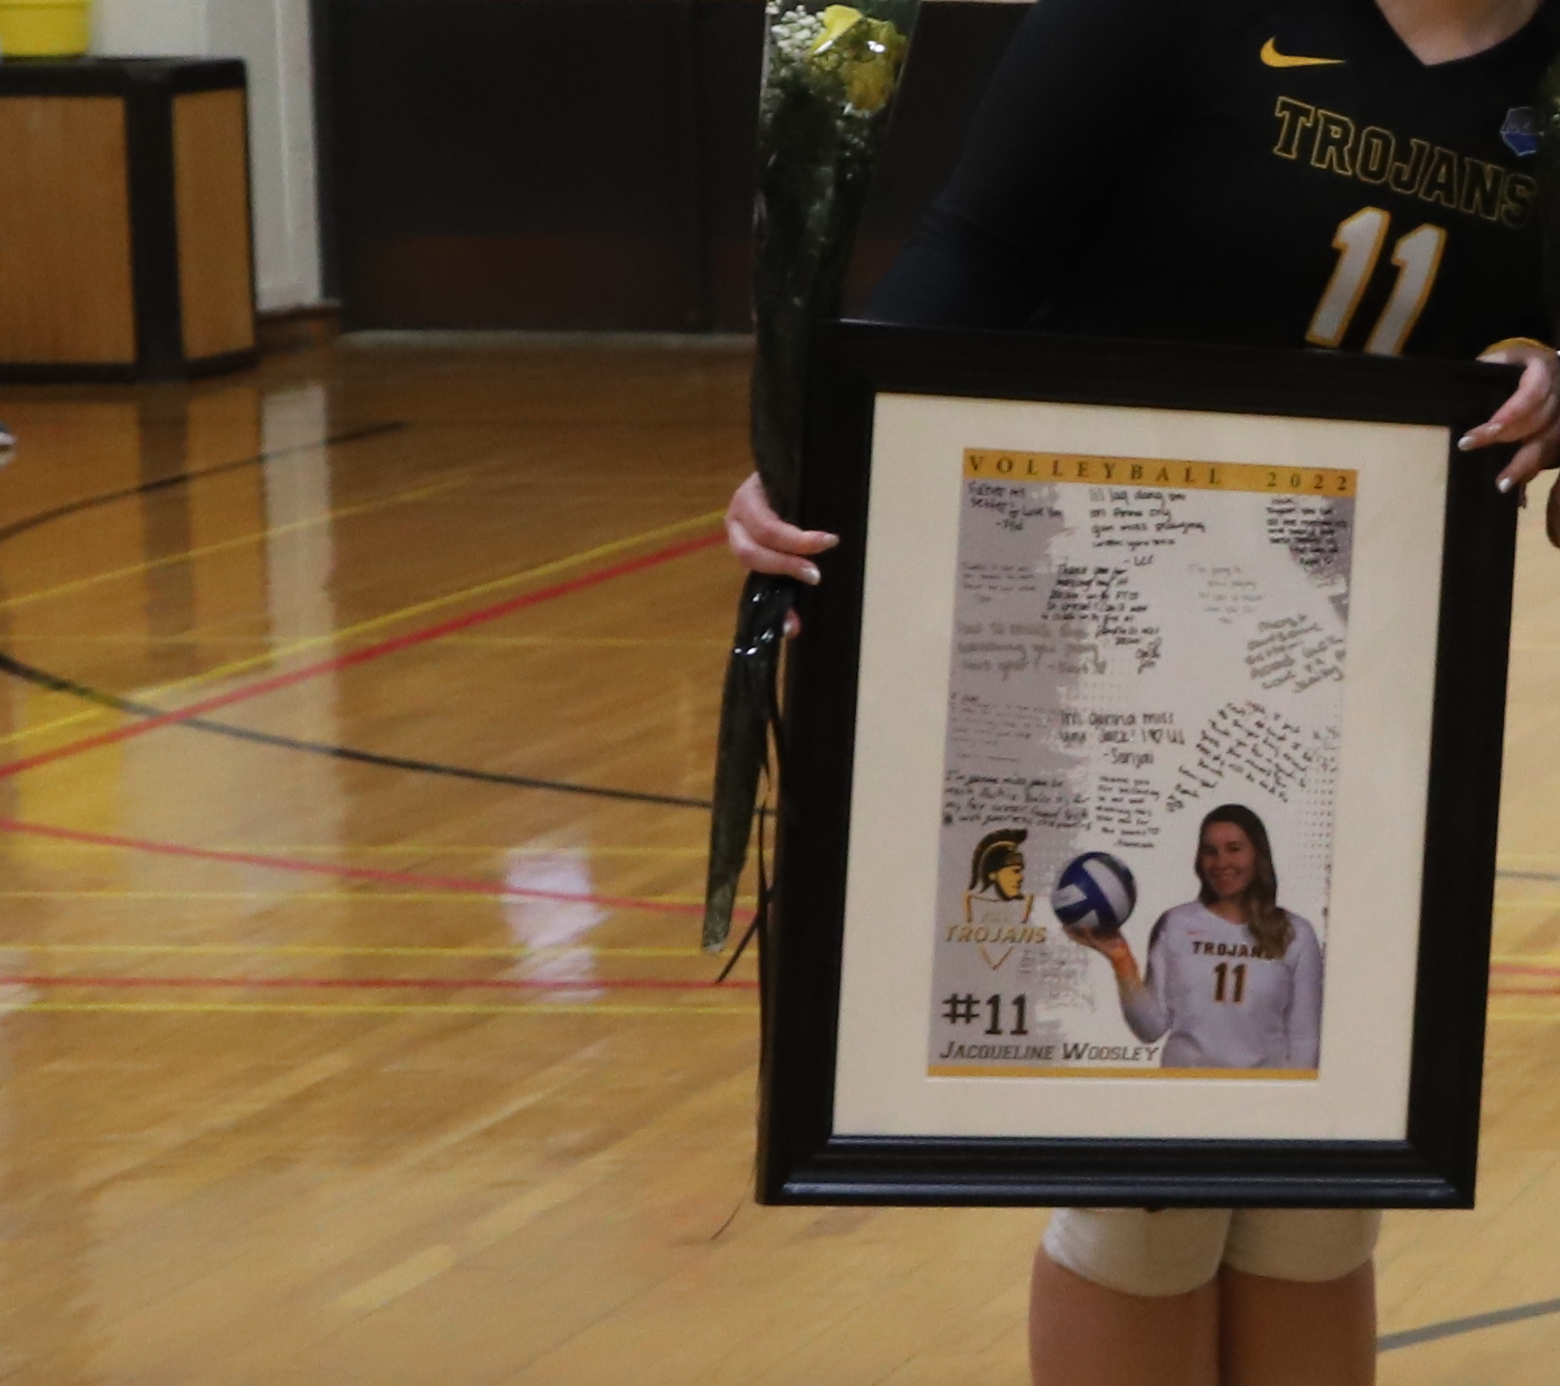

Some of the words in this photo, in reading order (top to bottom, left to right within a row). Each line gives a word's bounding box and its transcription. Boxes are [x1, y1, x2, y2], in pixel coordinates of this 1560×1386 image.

[1273, 95, 1537, 229] TROJANS
[1304, 205, 1448, 357] 11
[969, 455, 1222, 485] VOLLEYBALL
[1267, 471, 1348, 492] 2022
[945, 924, 1048, 943] TROJANS
[1191, 940, 1275, 960] TROJAN
[1211, 961, 1249, 1005] 11
[942, 992, 1029, 1037] #11
